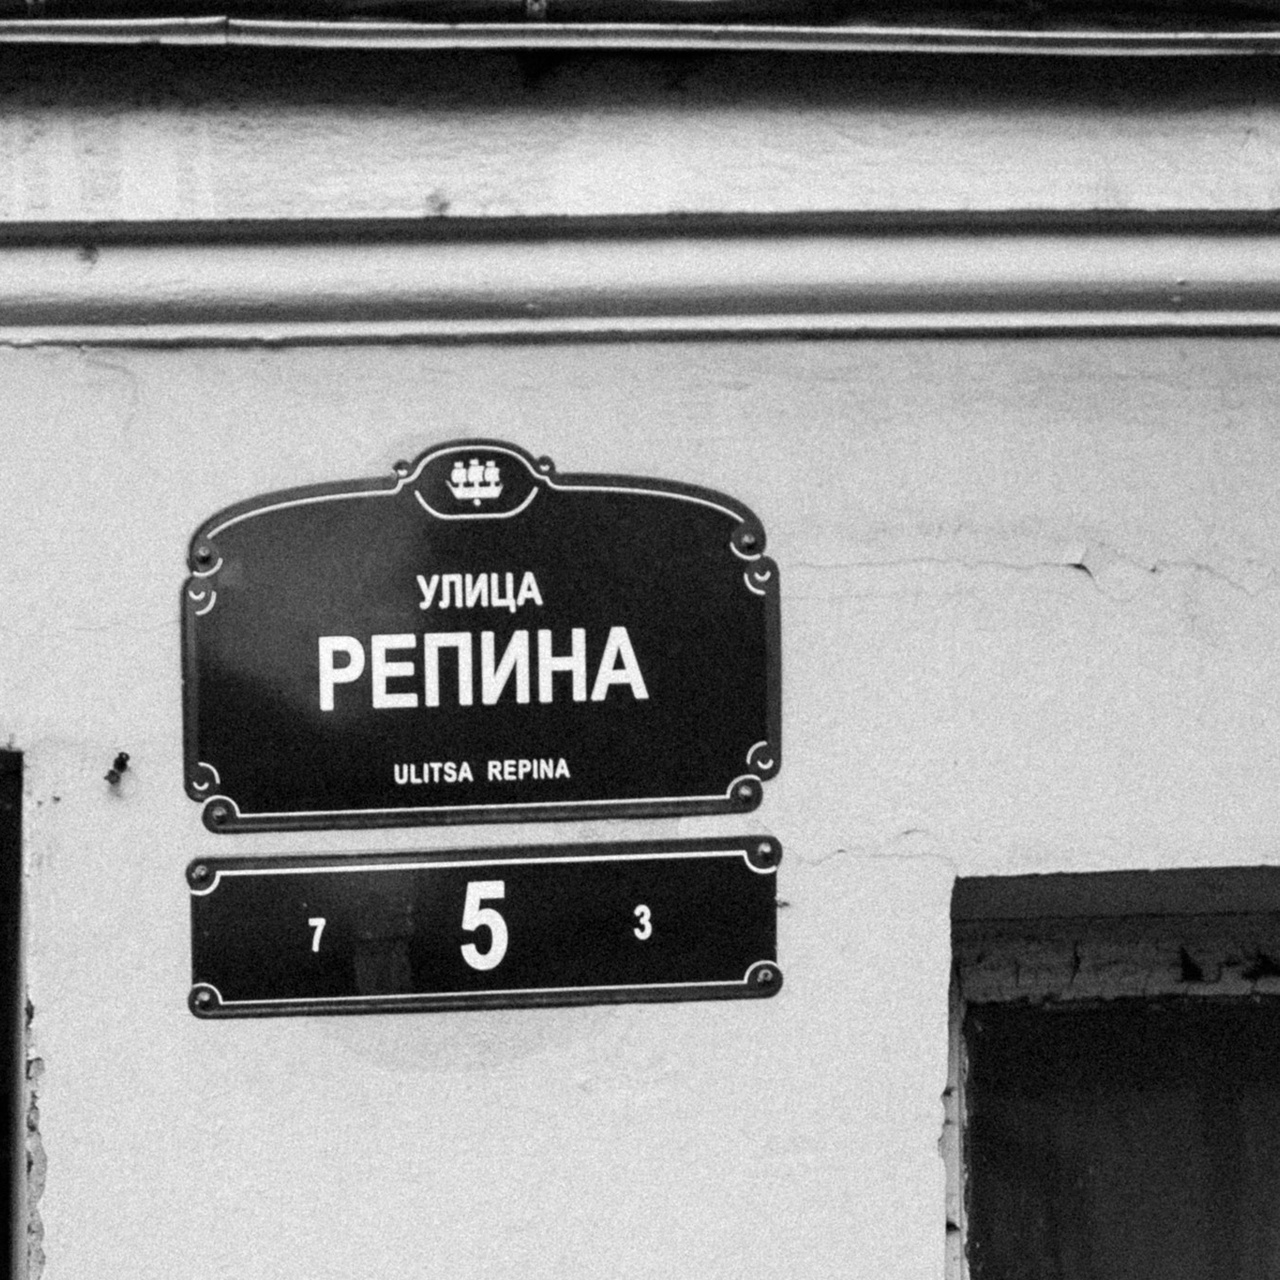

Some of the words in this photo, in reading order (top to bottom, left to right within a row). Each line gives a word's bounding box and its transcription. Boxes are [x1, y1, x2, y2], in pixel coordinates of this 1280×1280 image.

[416, 571, 544, 613] УЛИЦА
[318, 626, 649, 712] РЕПИНА
[393, 761, 474, 785] ULITSA
[487, 757, 571, 781] REPINA
[308, 917, 326, 953] 7
[460, 880, 509, 971] 5
[633, 904, 652, 940] 3
